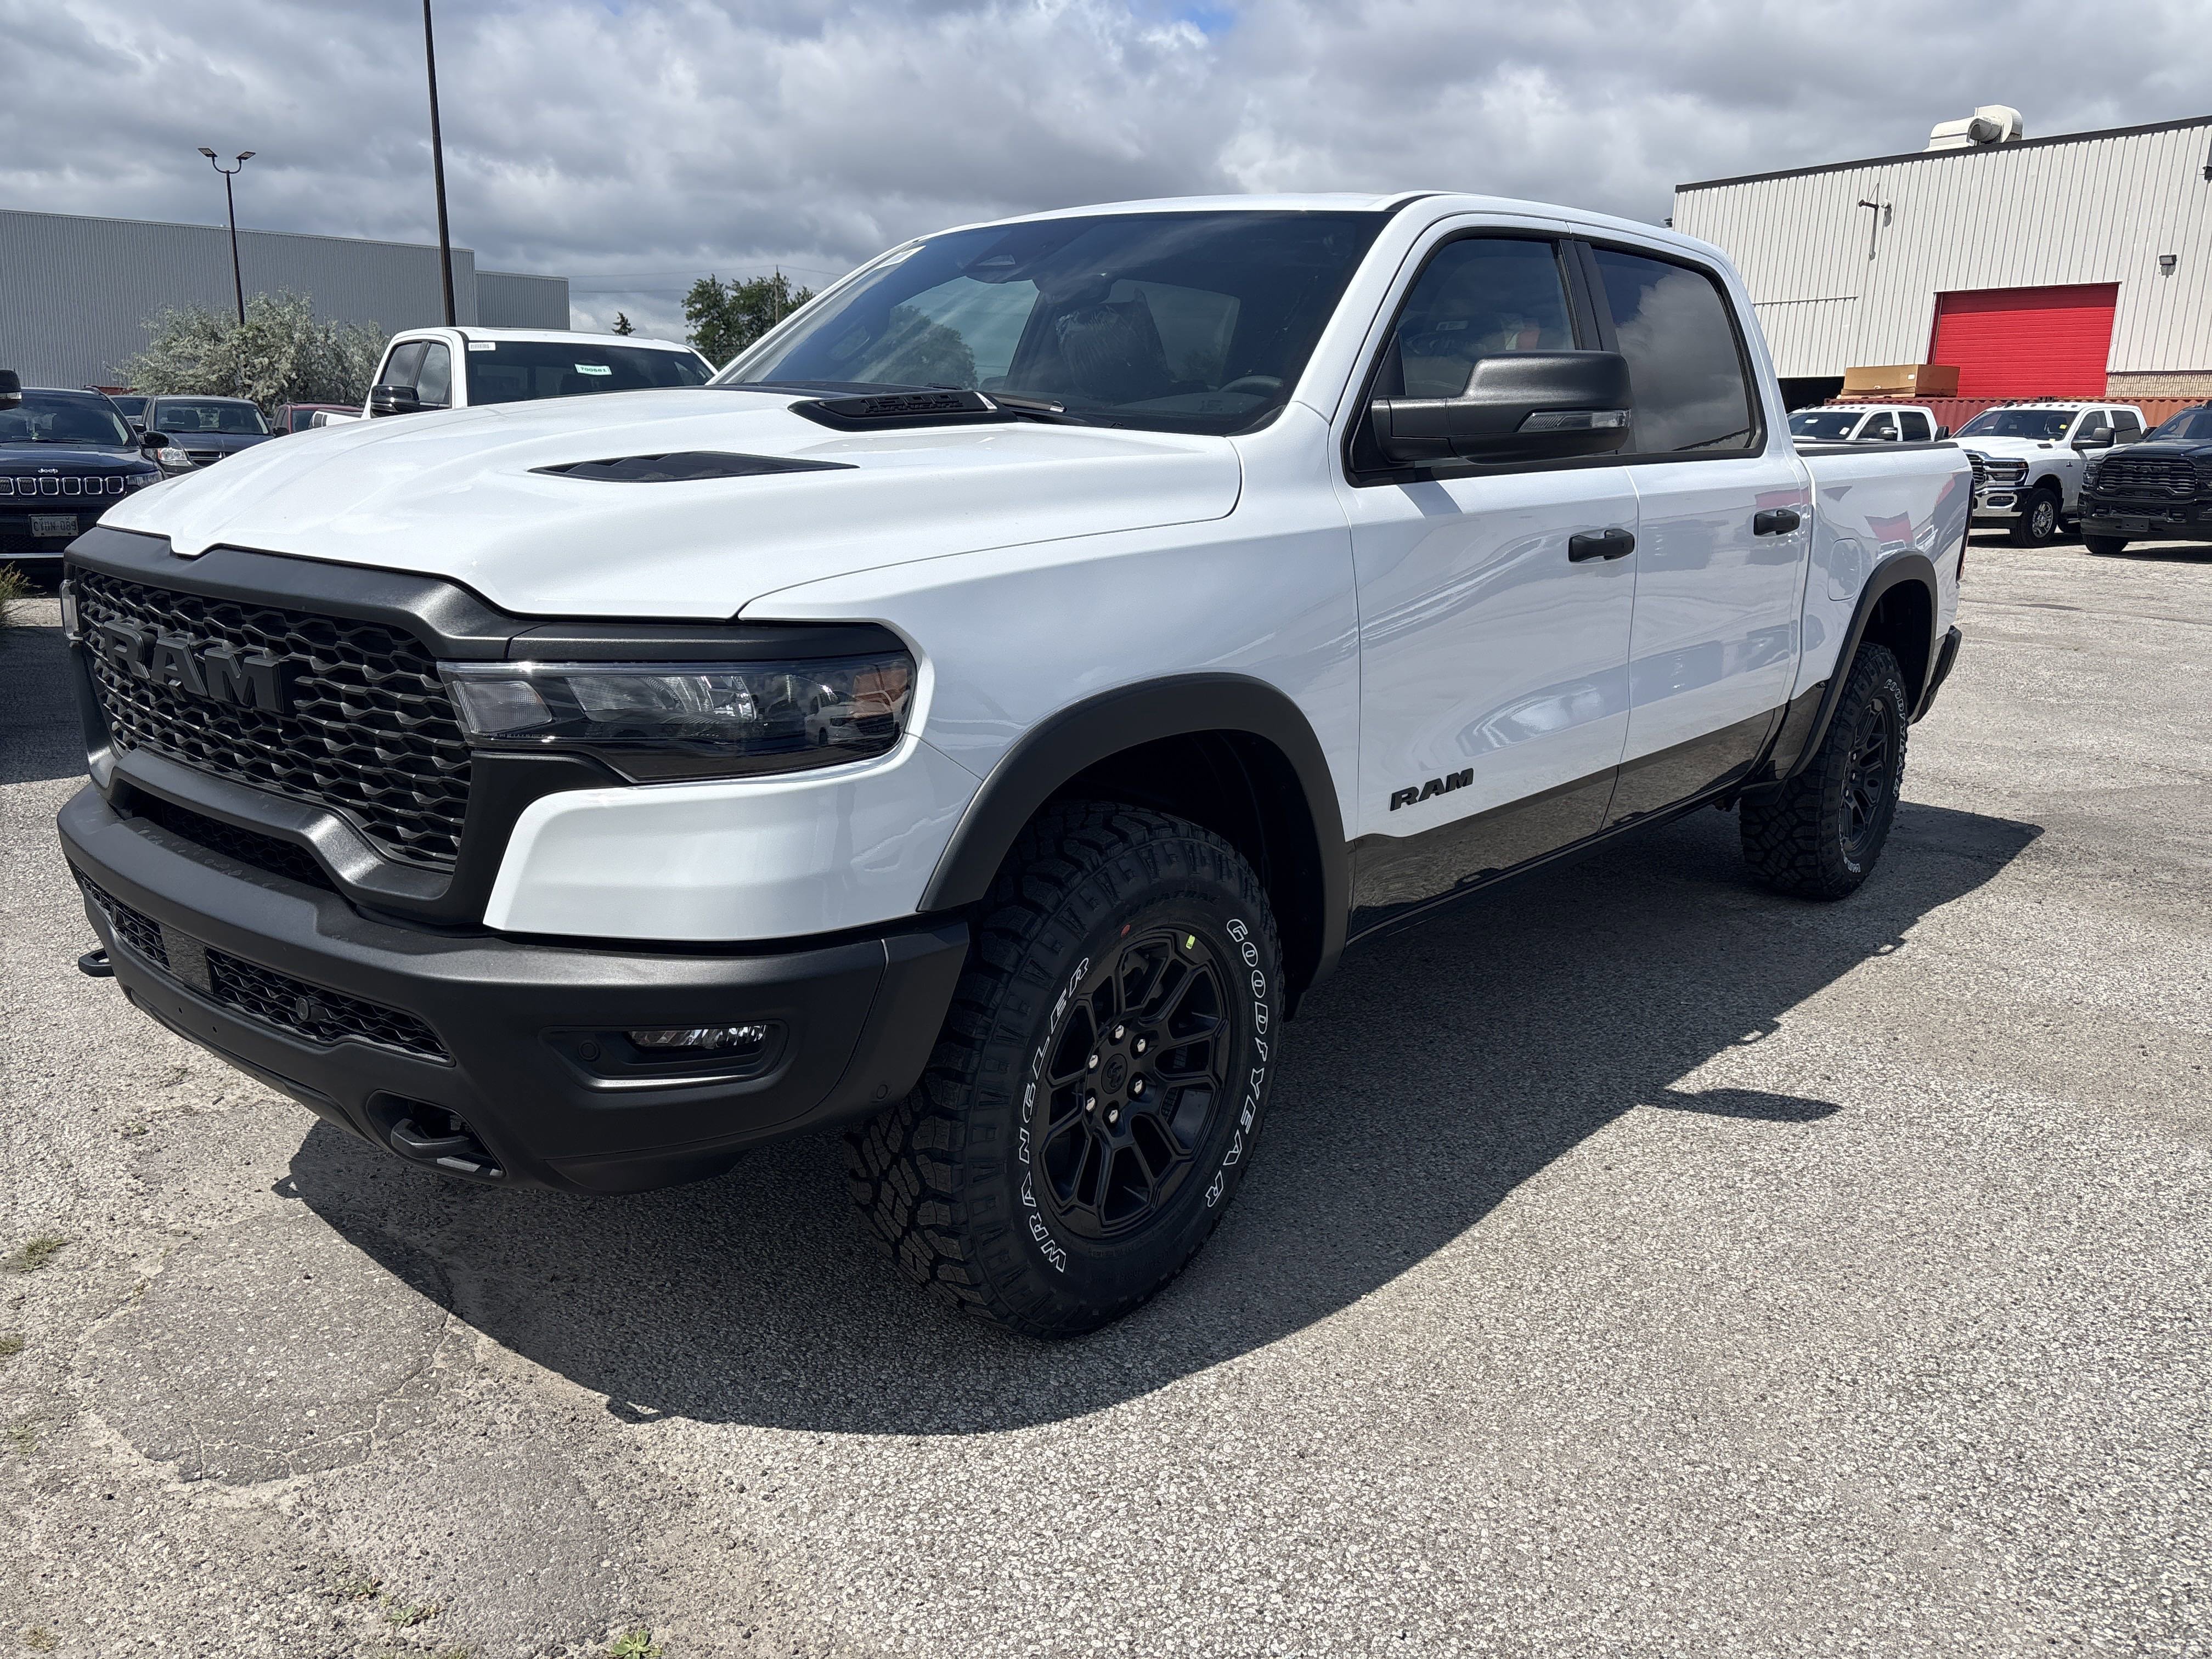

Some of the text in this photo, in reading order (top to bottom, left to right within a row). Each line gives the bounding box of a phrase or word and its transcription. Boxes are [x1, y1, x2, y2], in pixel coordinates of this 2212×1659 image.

[860, 394, 960, 409] 1500
[100, 620, 284, 713] RAM
[1389, 768, 1474, 811] RAM
[1883, 679, 1906, 798] GOODYEAR
[1019, 957, 1090, 1273] WRANGLER
[1204, 918, 1269, 1209] GOODYEAR
